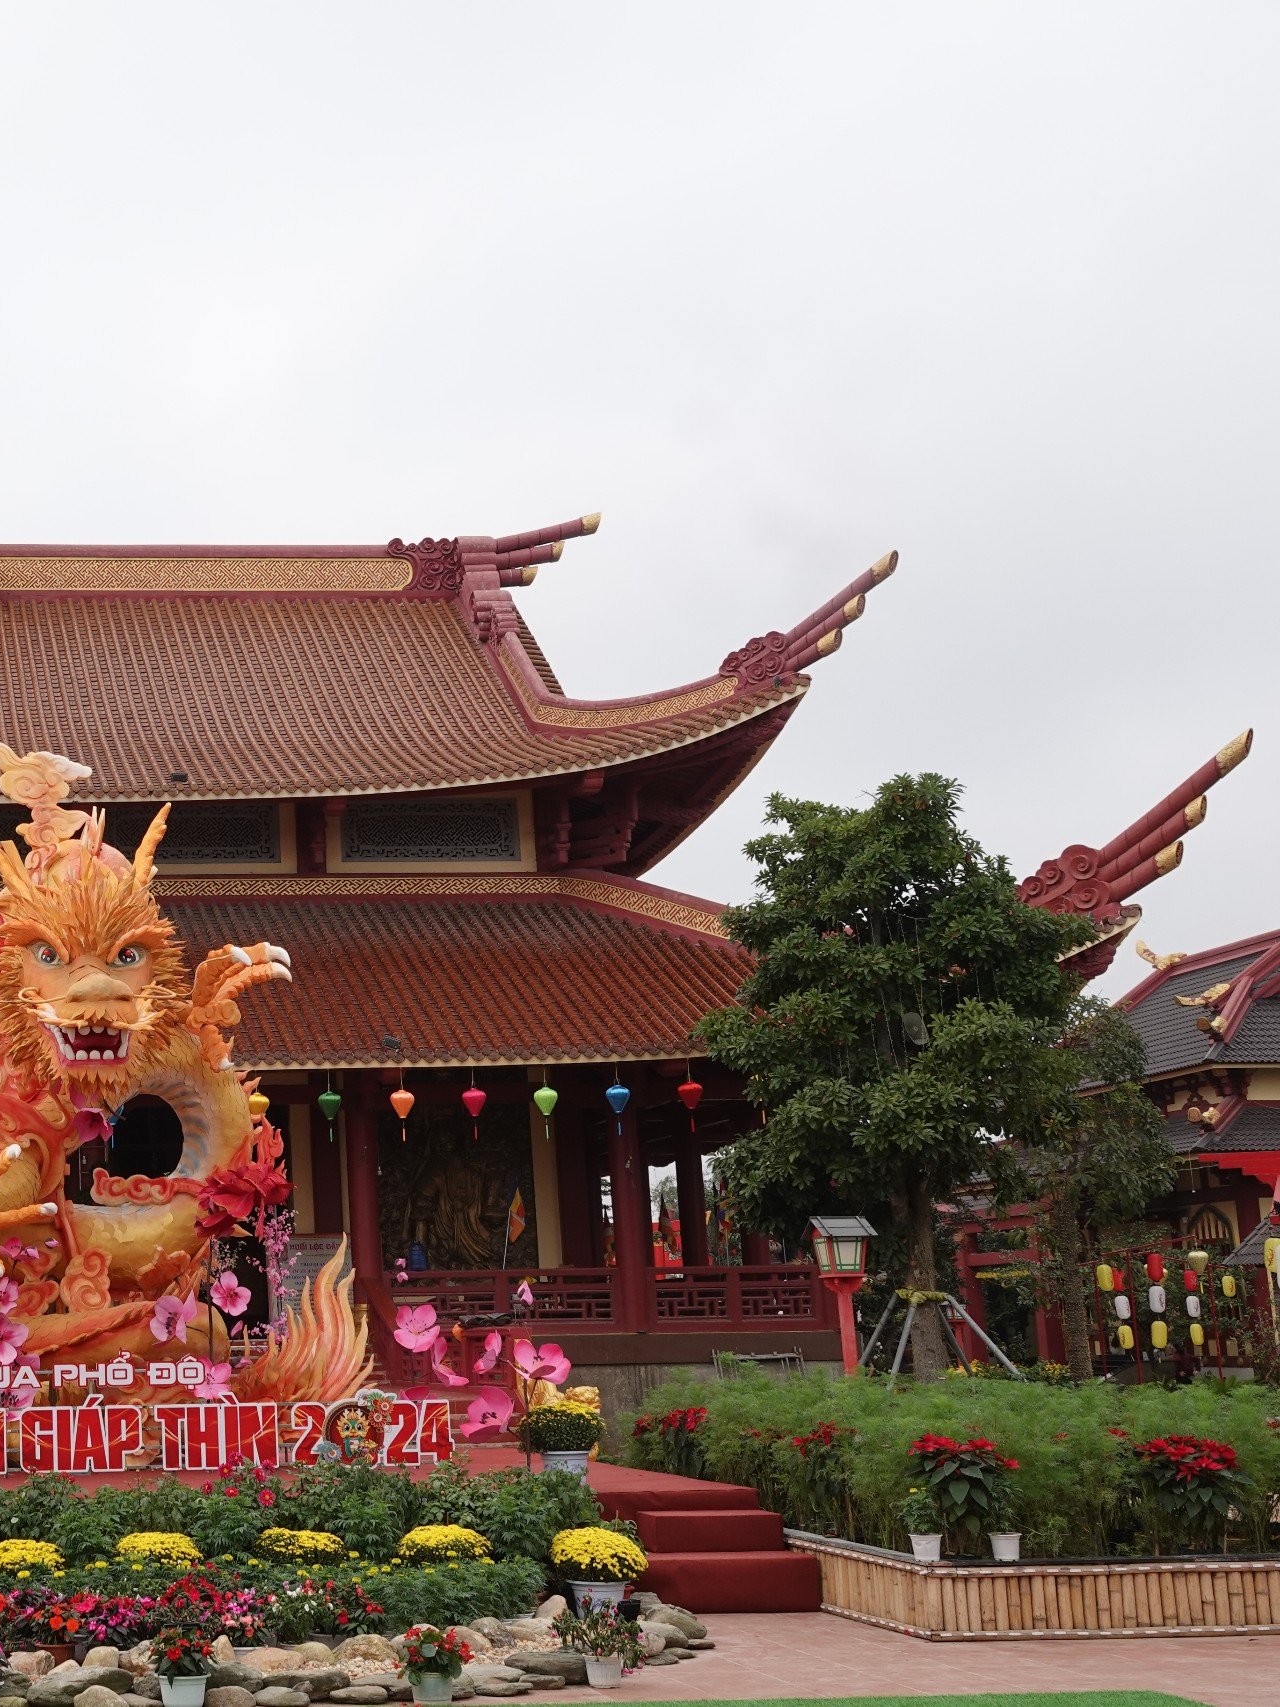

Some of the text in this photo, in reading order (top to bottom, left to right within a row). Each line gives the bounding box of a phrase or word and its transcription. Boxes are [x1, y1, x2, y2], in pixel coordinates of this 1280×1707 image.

[53, 1351, 134, 1387] PHỔ
[147, 1354, 205, 1390] ĐỘ
[21, 1394, 142, 1473] GIÁP
[154, 1392, 279, 1471] THÌN
